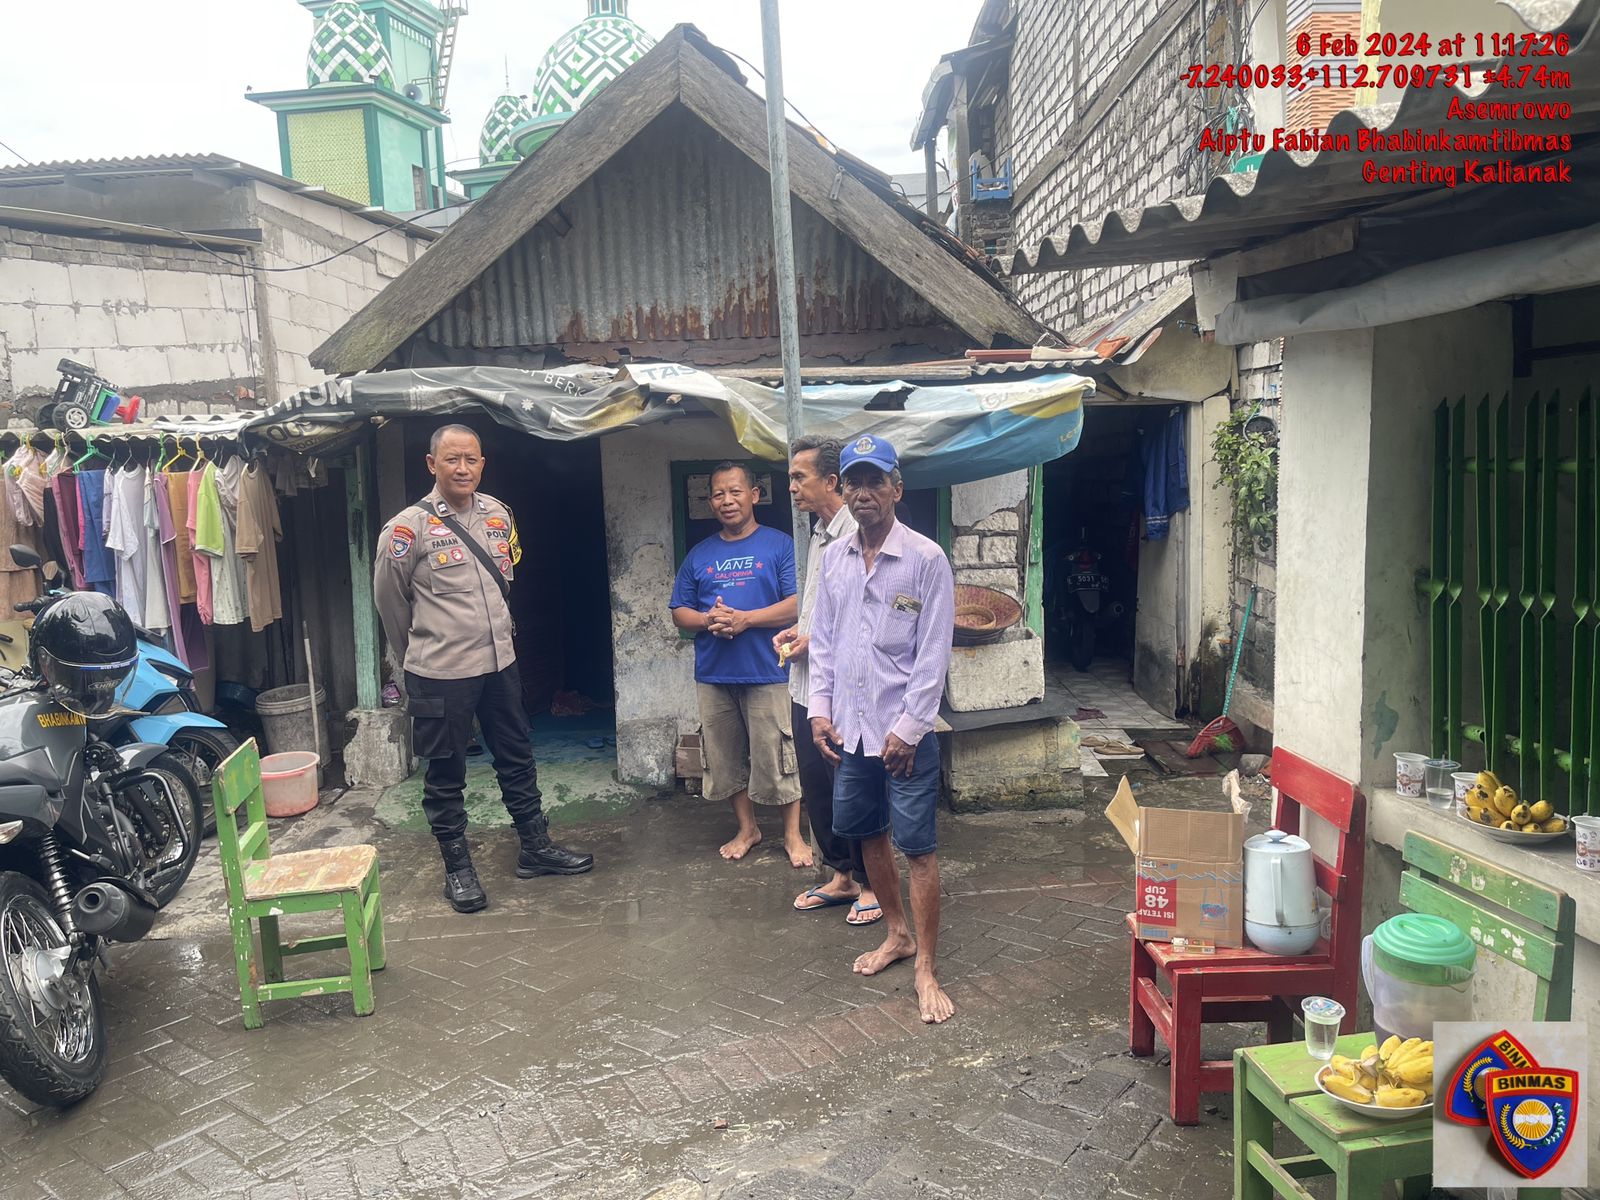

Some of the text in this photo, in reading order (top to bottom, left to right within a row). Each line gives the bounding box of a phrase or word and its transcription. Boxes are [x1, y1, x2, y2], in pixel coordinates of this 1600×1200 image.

[432, 538, 459, 549] FABIAN
[715, 556, 755, 571] VANS
[1145, 885, 1167, 895] CUP
[1144, 894, 1169, 909] 48
[1137, 908, 1174, 919] ISI TETAP
